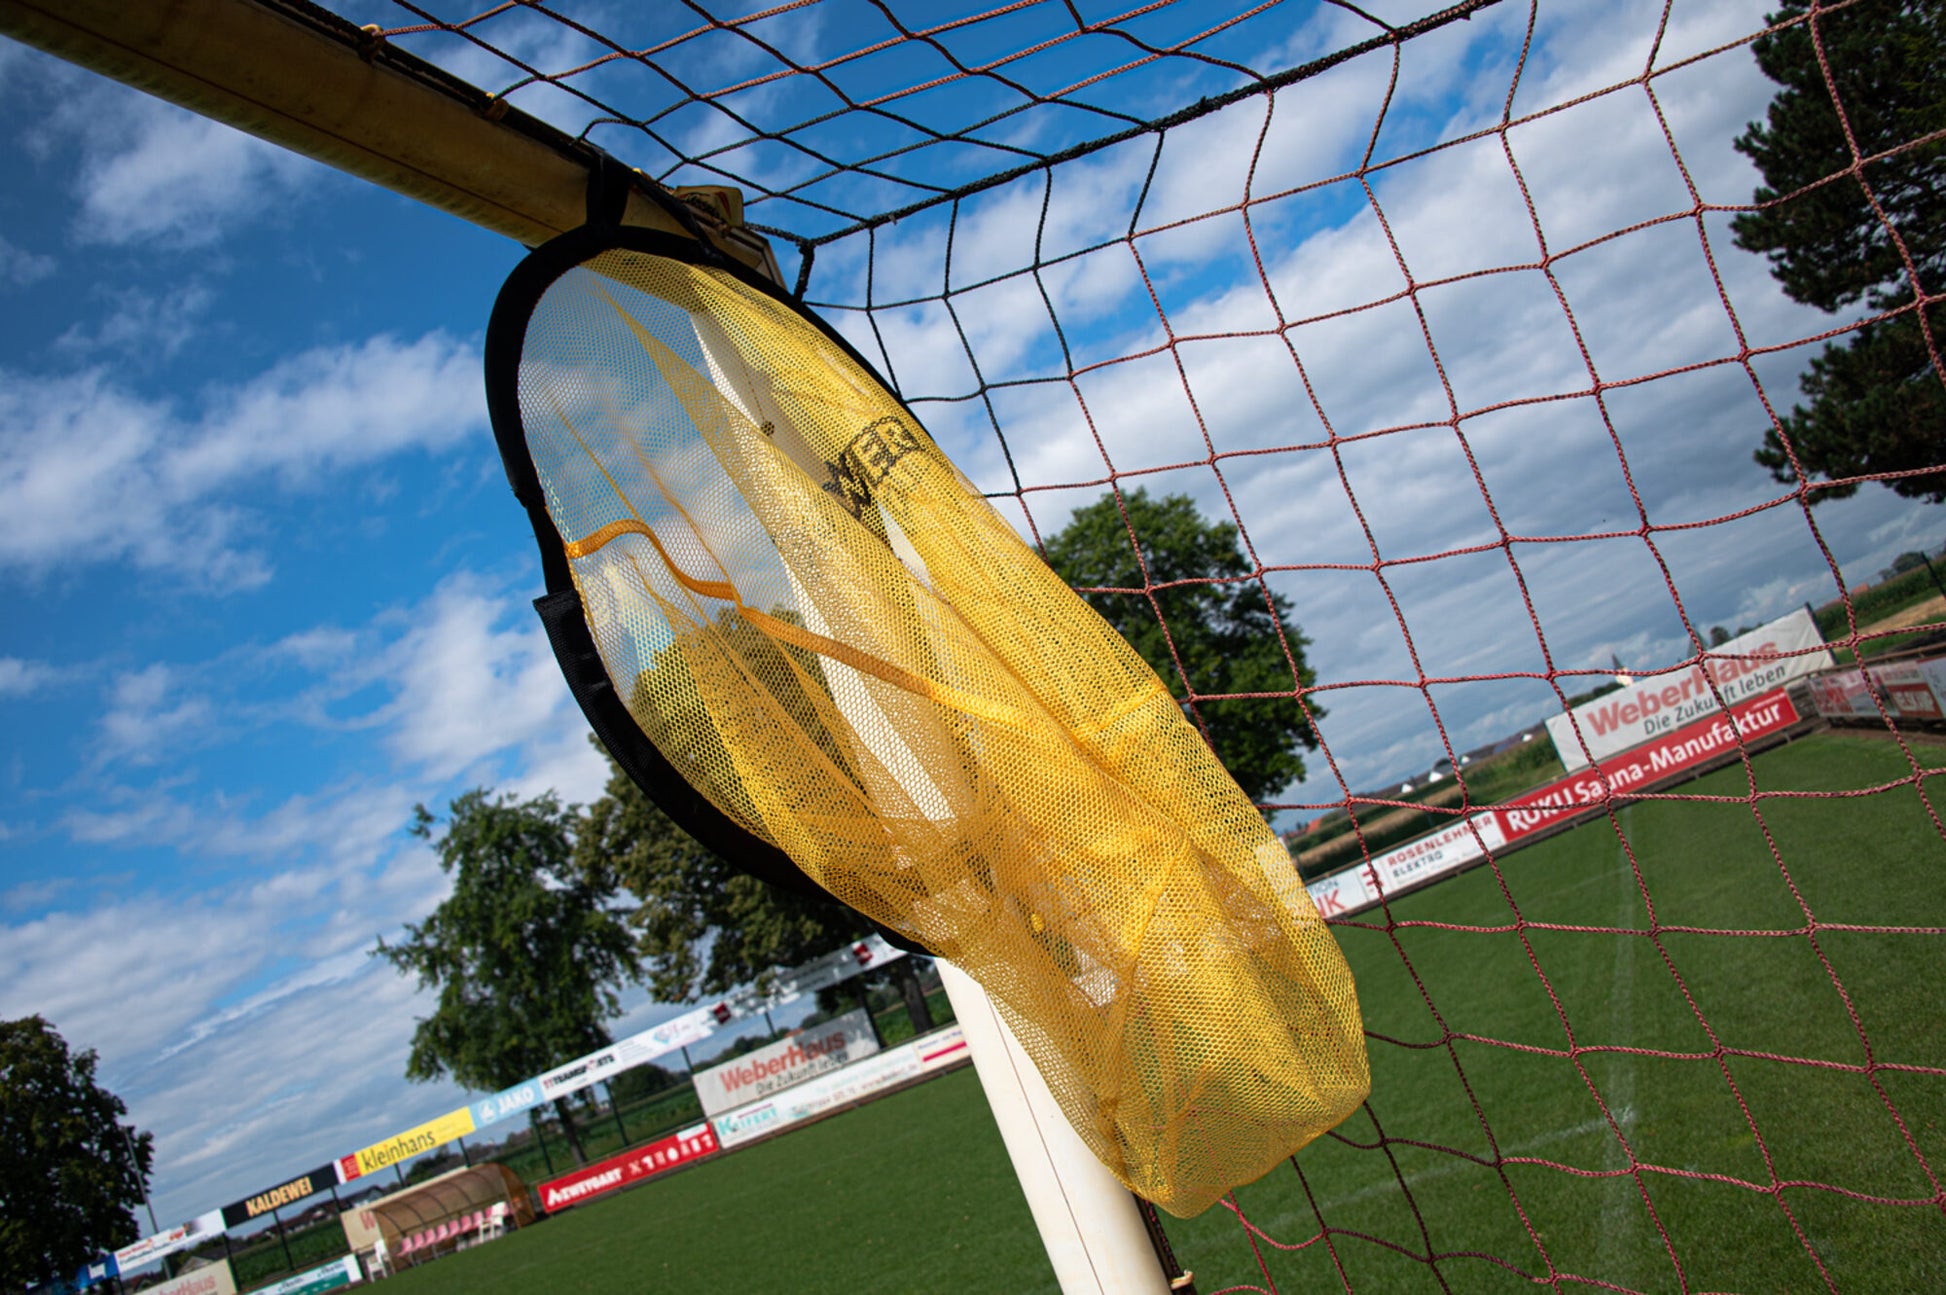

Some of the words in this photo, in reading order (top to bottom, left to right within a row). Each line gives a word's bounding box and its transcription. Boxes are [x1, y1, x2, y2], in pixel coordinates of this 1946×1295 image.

[1586, 641, 1779, 737] WeberHaus
[1643, 713, 1671, 735] Die
[1739, 665, 1786, 693] leben
[1505, 785, 1574, 833] RUKU
[1574, 702, 1781, 803] Sauna-Manufaktur
[1387, 815, 1493, 867] ROSENLEHNER
[1392, 851, 1444, 878] ELEKTRO
[720, 1031, 846, 1092] WeberHaus
[499, 1085, 535, 1114] JAKO
[755, 1079, 774, 1094] Die
[361, 1130, 436, 1173] kleinhans
[245, 1176, 314, 1218] KALDEWEI
